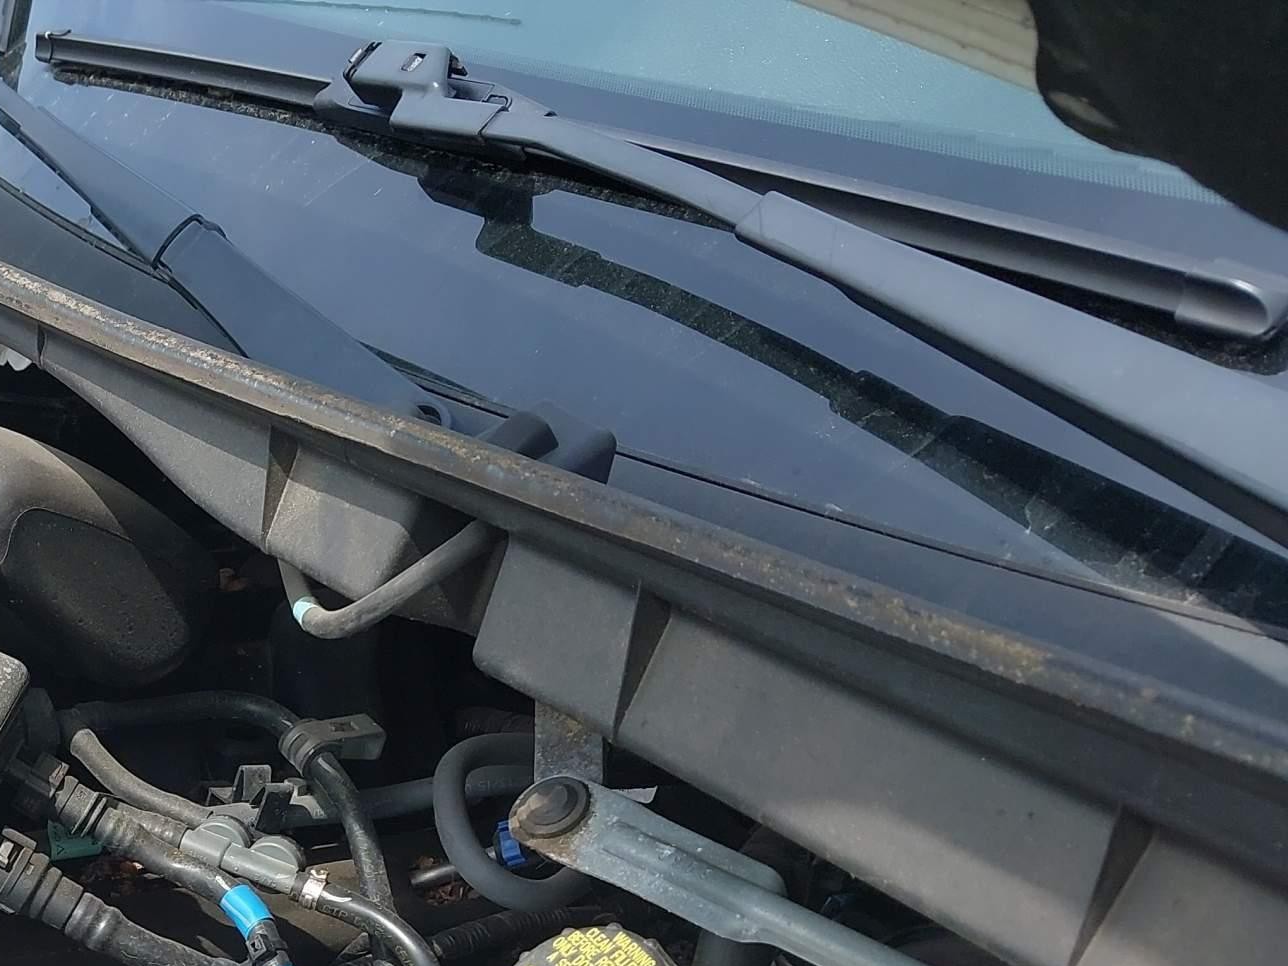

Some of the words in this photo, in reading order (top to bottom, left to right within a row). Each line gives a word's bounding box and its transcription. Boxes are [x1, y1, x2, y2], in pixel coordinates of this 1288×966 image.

[552, 937, 576, 958] ONLY
[568, 931, 599, 959] BEFORE
[587, 928, 615, 952] CLEAN
